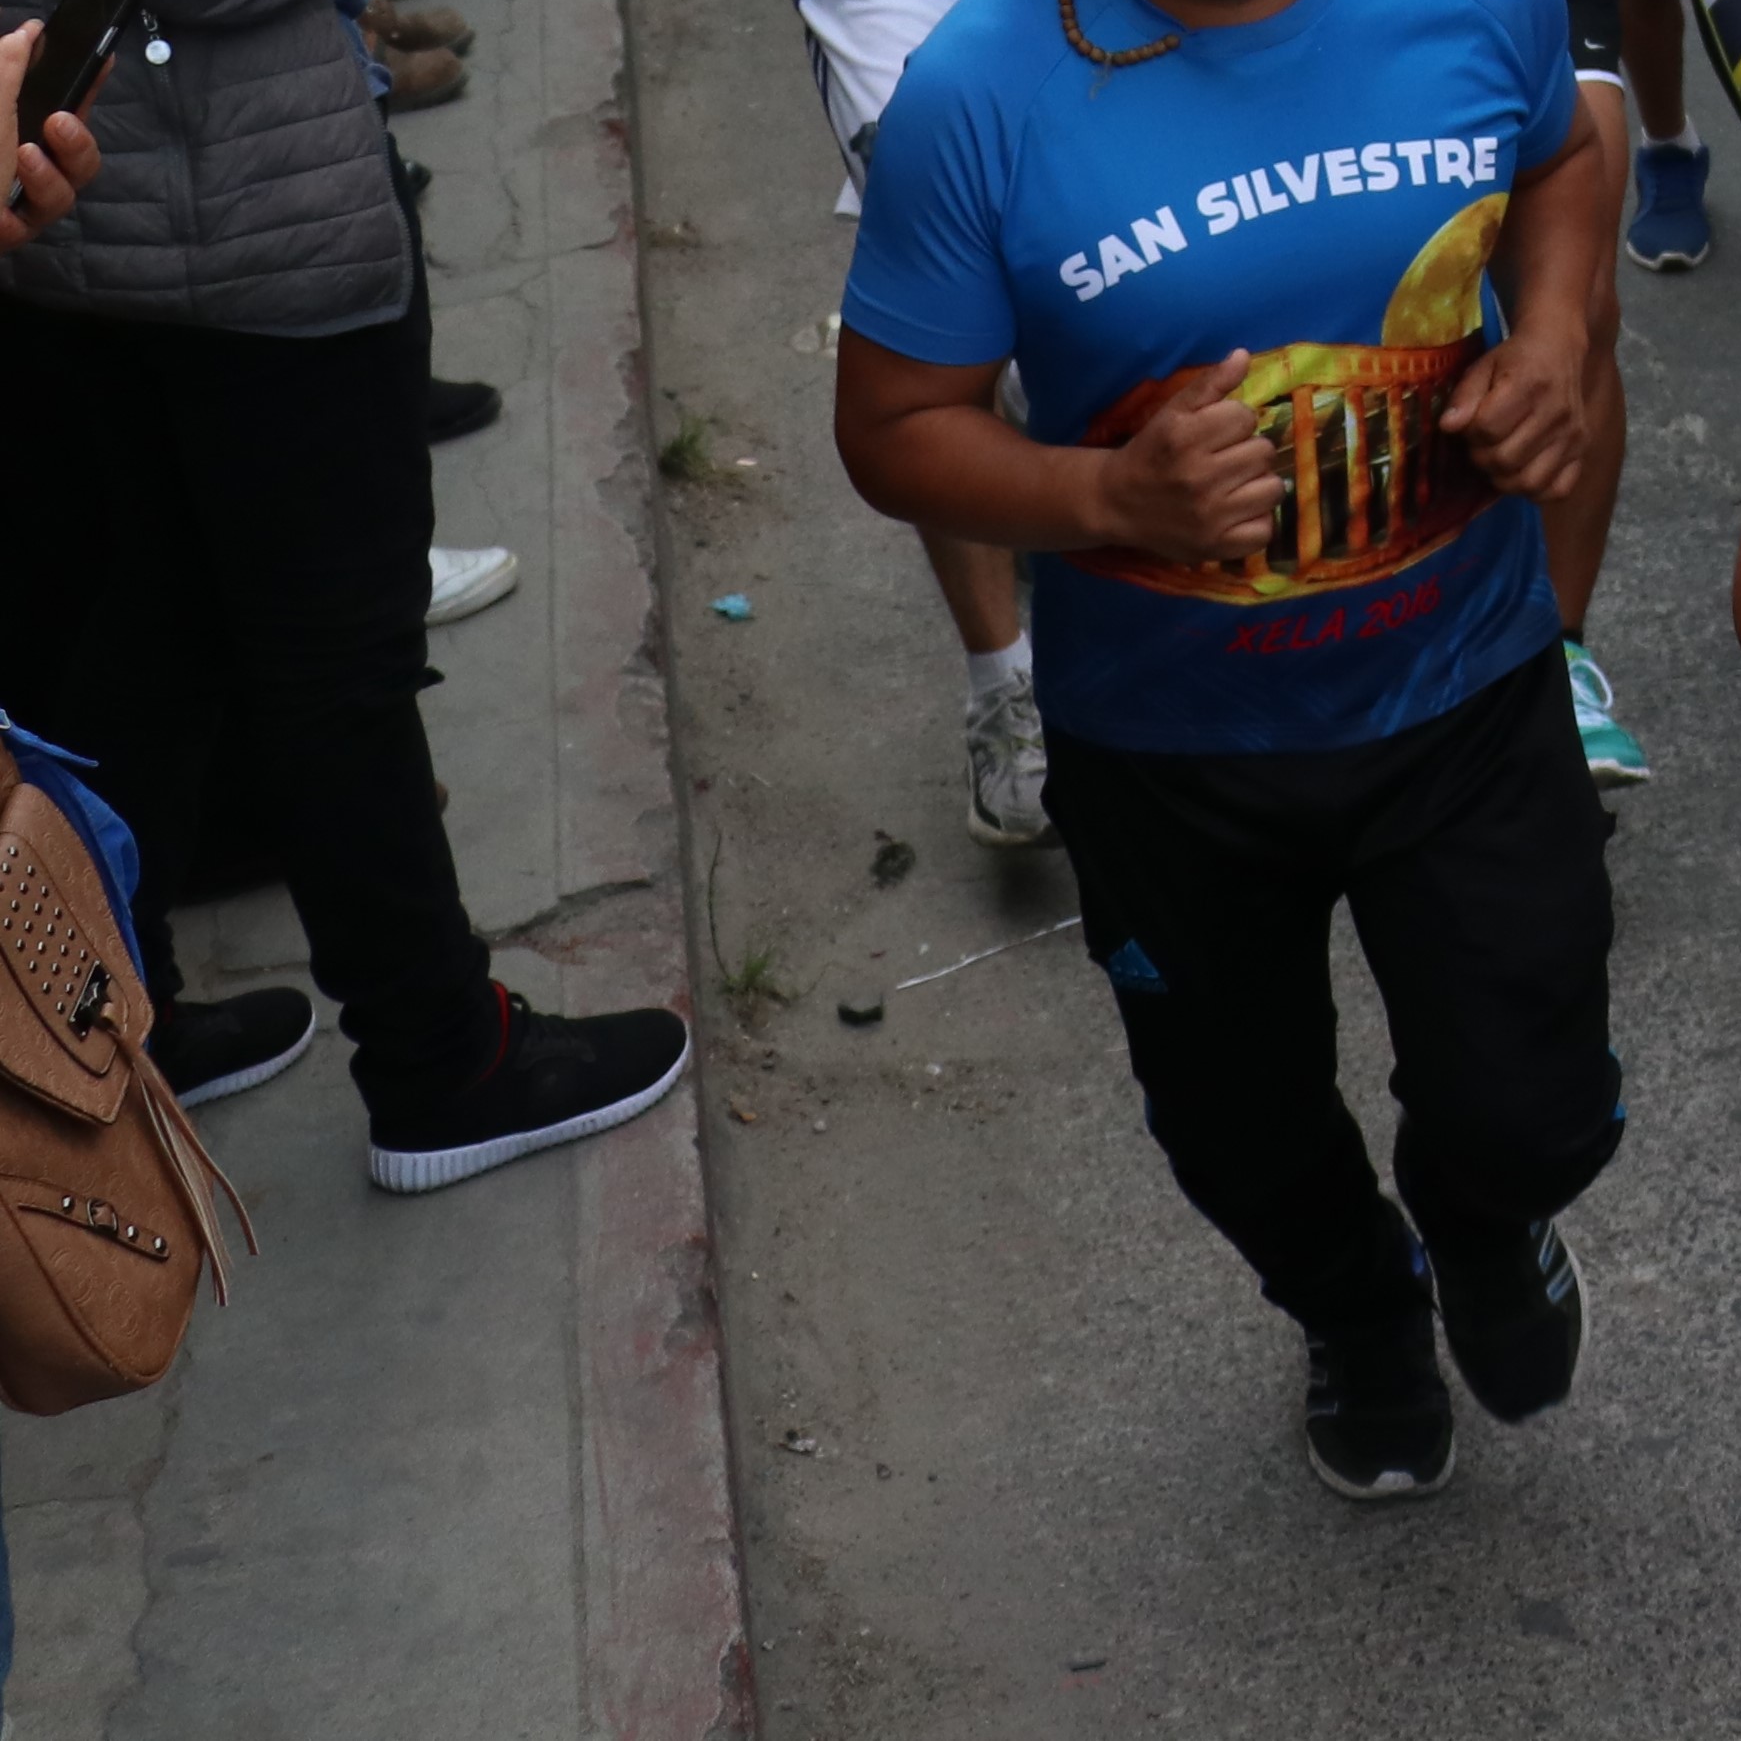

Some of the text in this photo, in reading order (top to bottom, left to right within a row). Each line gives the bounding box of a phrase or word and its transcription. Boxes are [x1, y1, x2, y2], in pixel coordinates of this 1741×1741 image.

[1058, 136, 1499, 303] SAN SILVESTRE
[1225, 607, 1346, 654] XELA
